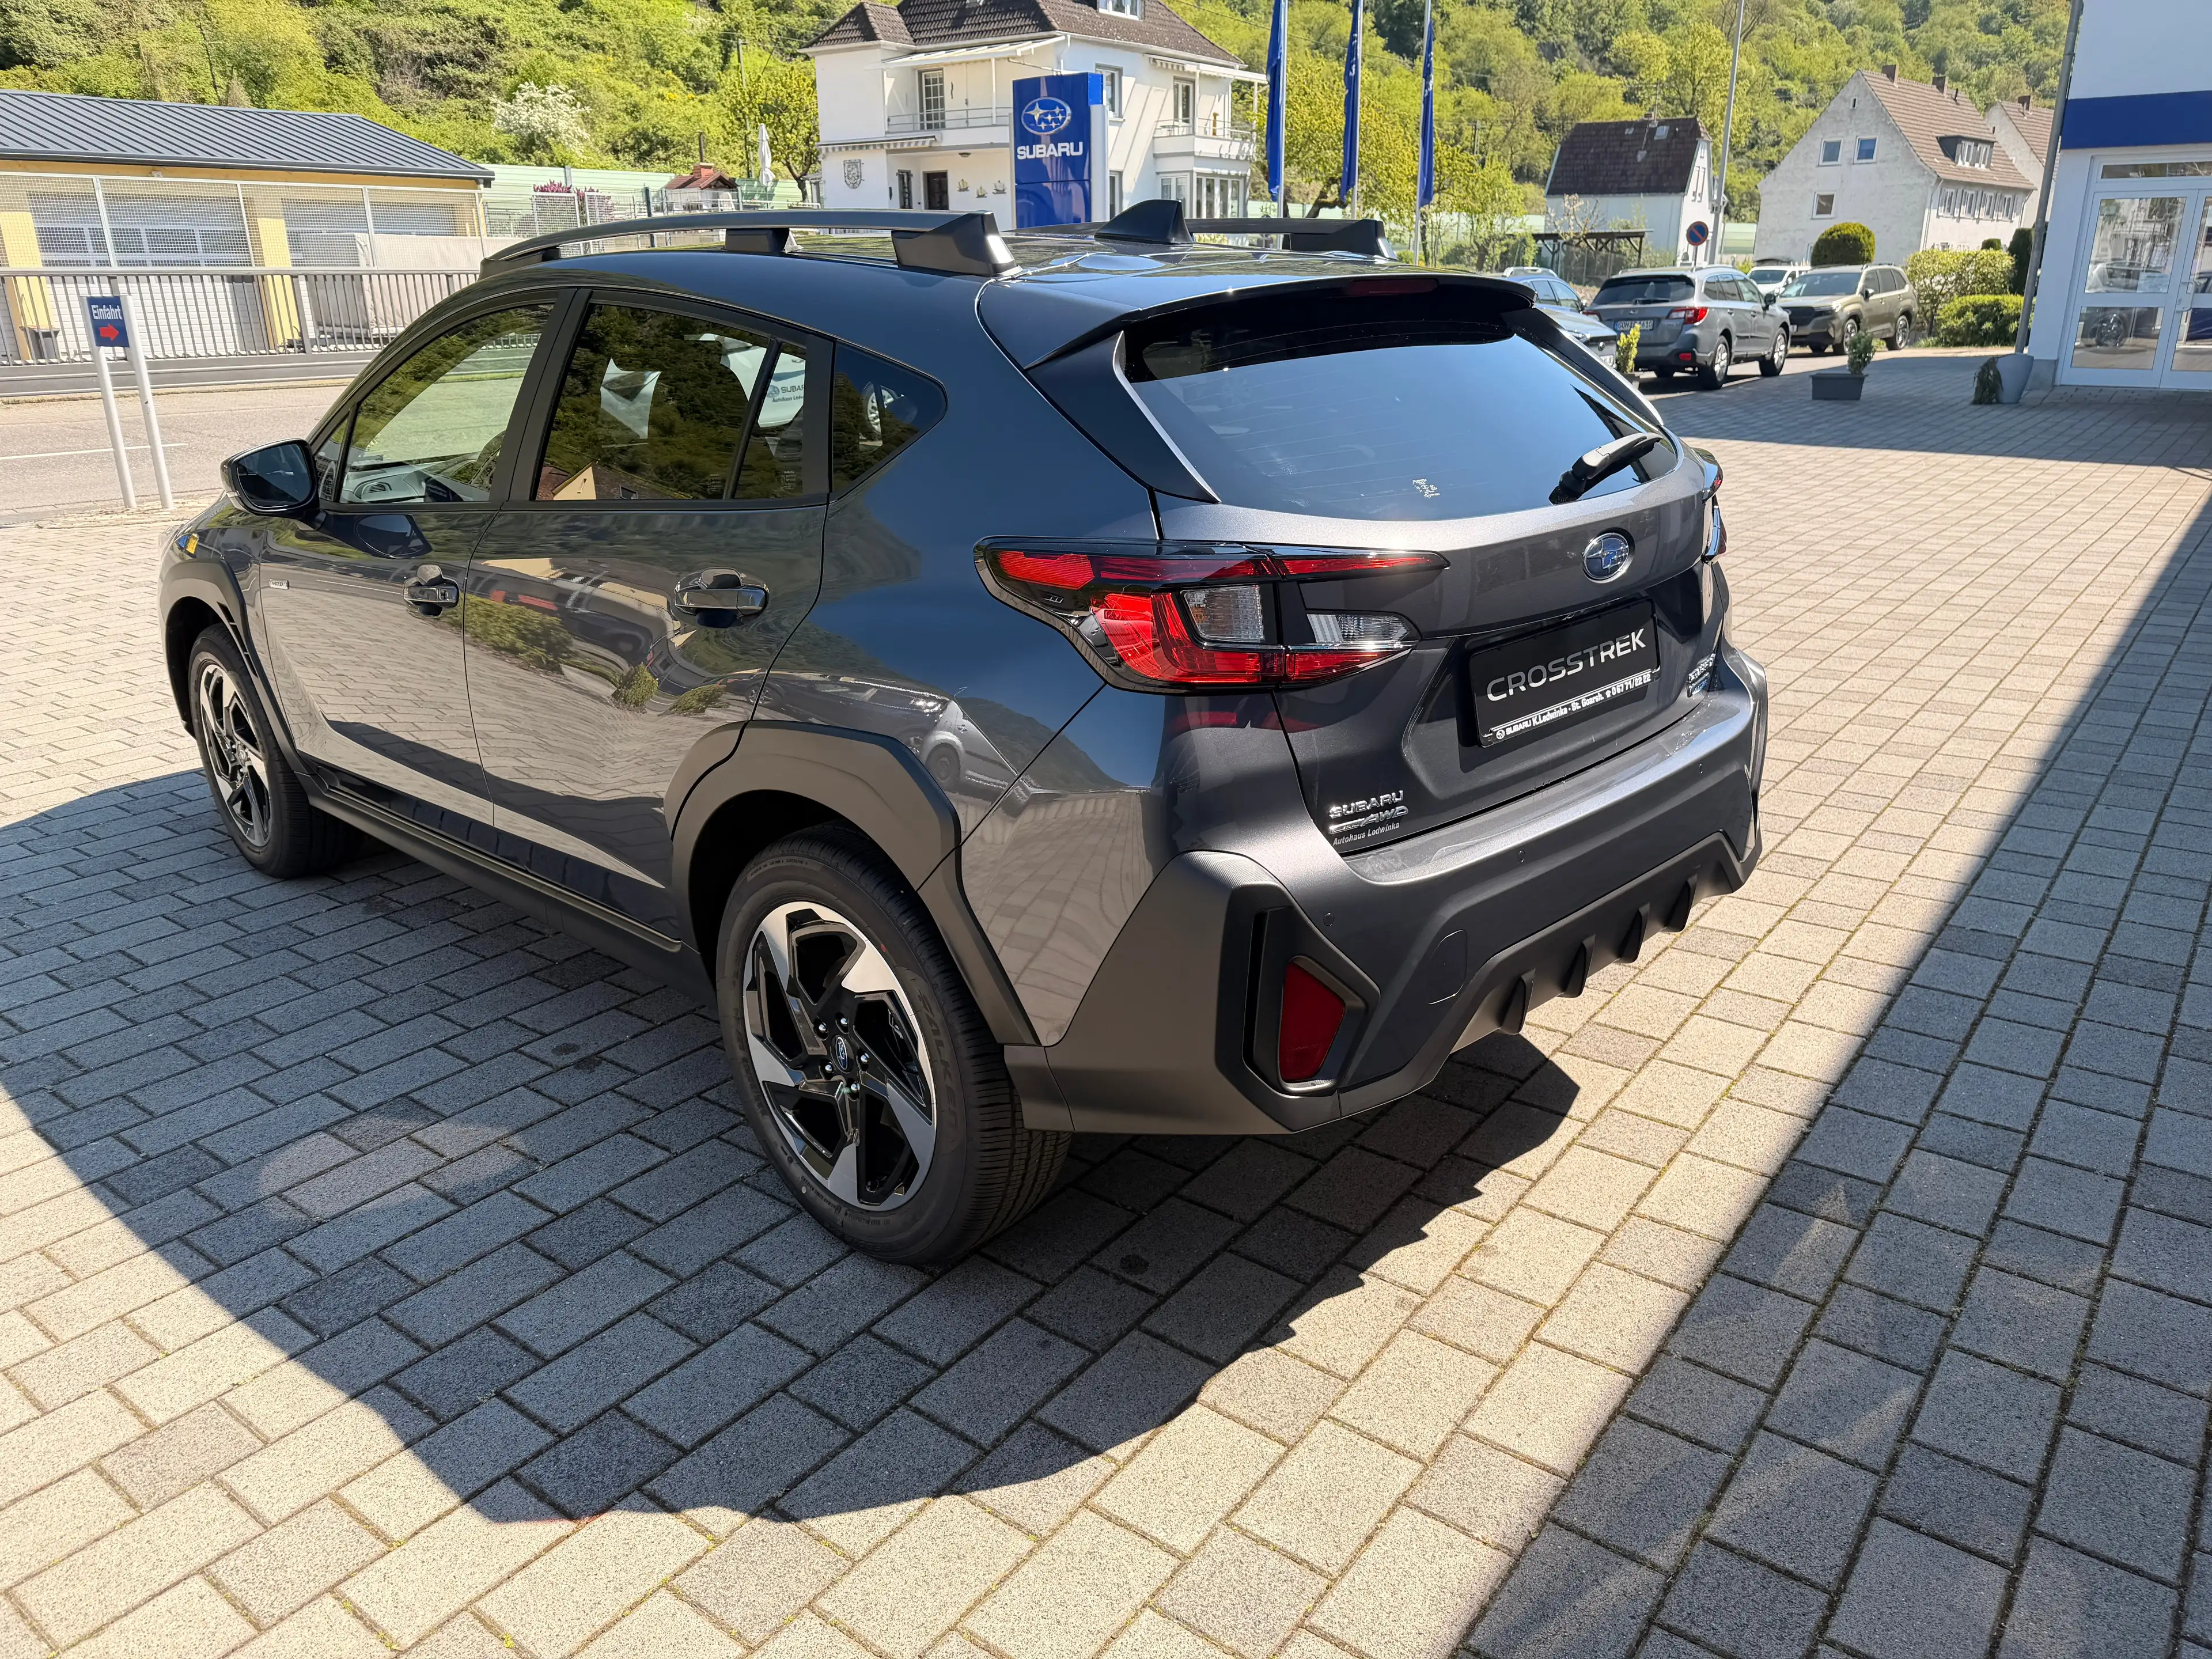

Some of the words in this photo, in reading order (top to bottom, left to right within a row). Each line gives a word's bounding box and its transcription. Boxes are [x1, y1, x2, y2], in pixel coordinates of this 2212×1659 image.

[1017, 142, 1083, 160] SUBARU
[91, 305, 123, 320] Einfahrt
[1487, 628, 1646, 702] CROSSTREK
[1505, 719, 1532, 735] SUBARU
[1571, 702, 1581, 711] St.
[1329, 790, 1404, 819] SUBARU
[1361, 805, 1409, 826] AWD
[1332, 832, 1366, 846] Autohaus
